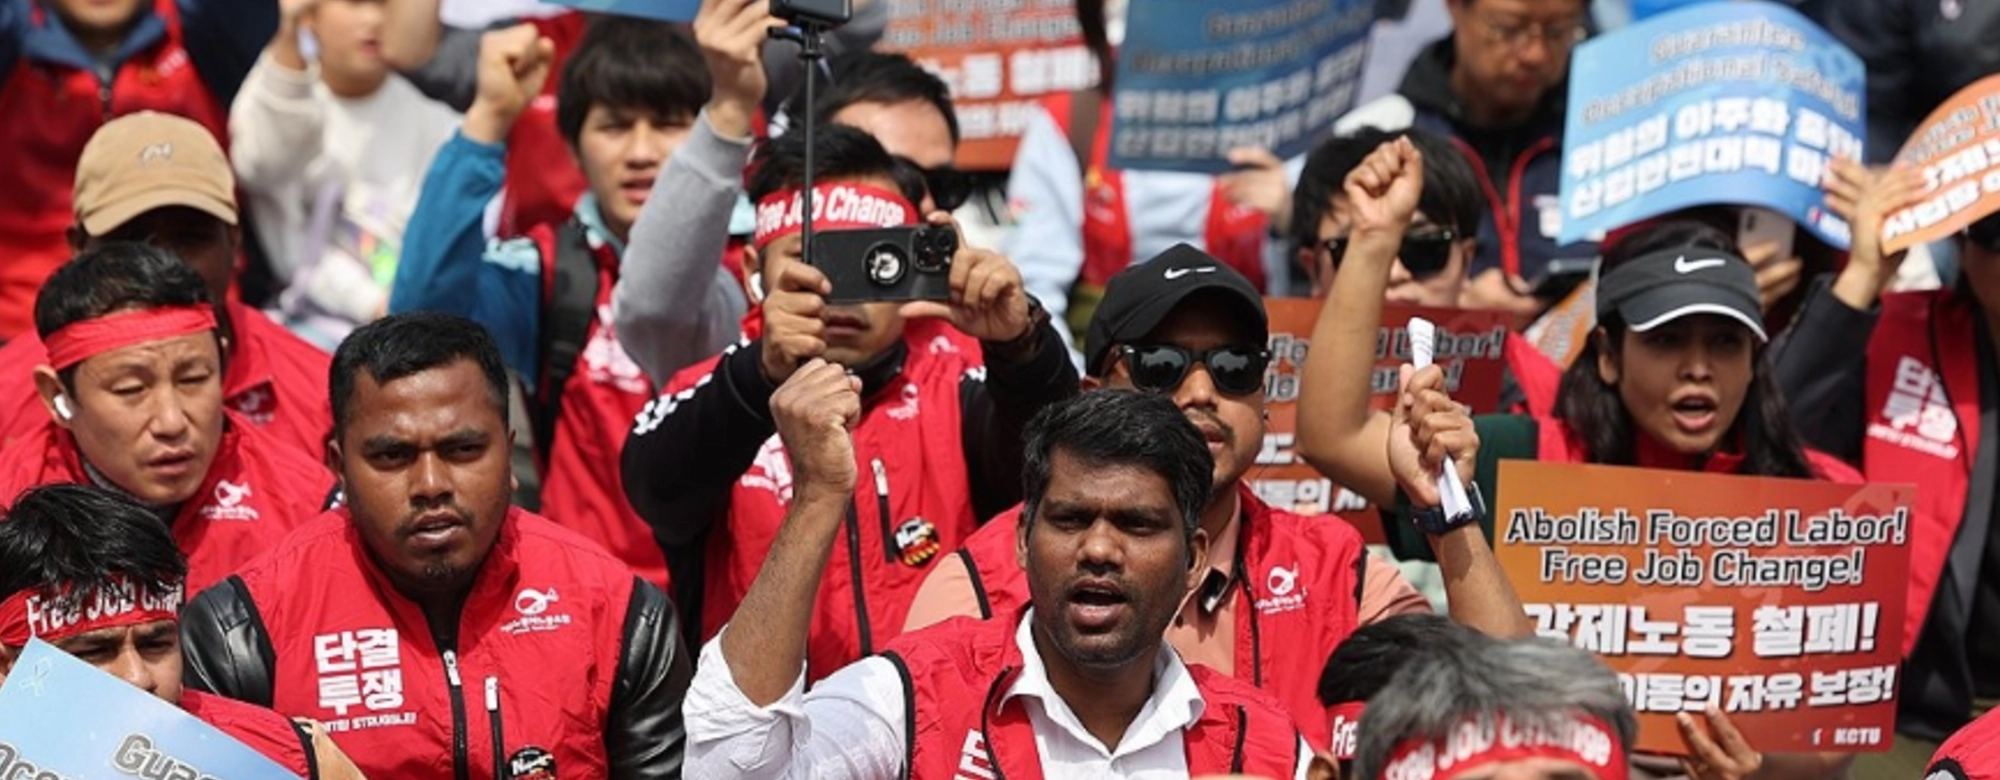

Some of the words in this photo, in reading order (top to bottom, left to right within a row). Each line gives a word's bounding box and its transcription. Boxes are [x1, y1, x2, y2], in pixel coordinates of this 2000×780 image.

[826, 186, 905, 228] Change
[1393, 324, 1506, 361] Lbor!
[1504, 506, 1639, 544] Abolish
[1646, 508, 1779, 547] Forced
[1785, 506, 1908, 547] Labor!
[1541, 547, 1628, 584] Free
[1633, 548, 1704, 586] Job
[1711, 546, 1865, 591] Change!
[314, 628, 400, 674] 단결
[1522, 603, 1735, 658] 강제노동
[1753, 602, 1880, 657] 철폐!
[318, 667, 404, 716] 투쟁
[1726, 673, 1803, 713] 자유
[1808, 665, 1897, 706] 보장!
[111, 731, 226, 780] Gua
[1331, 714, 1359, 757] Fre
[1834, 726, 1882, 746] KCTU
